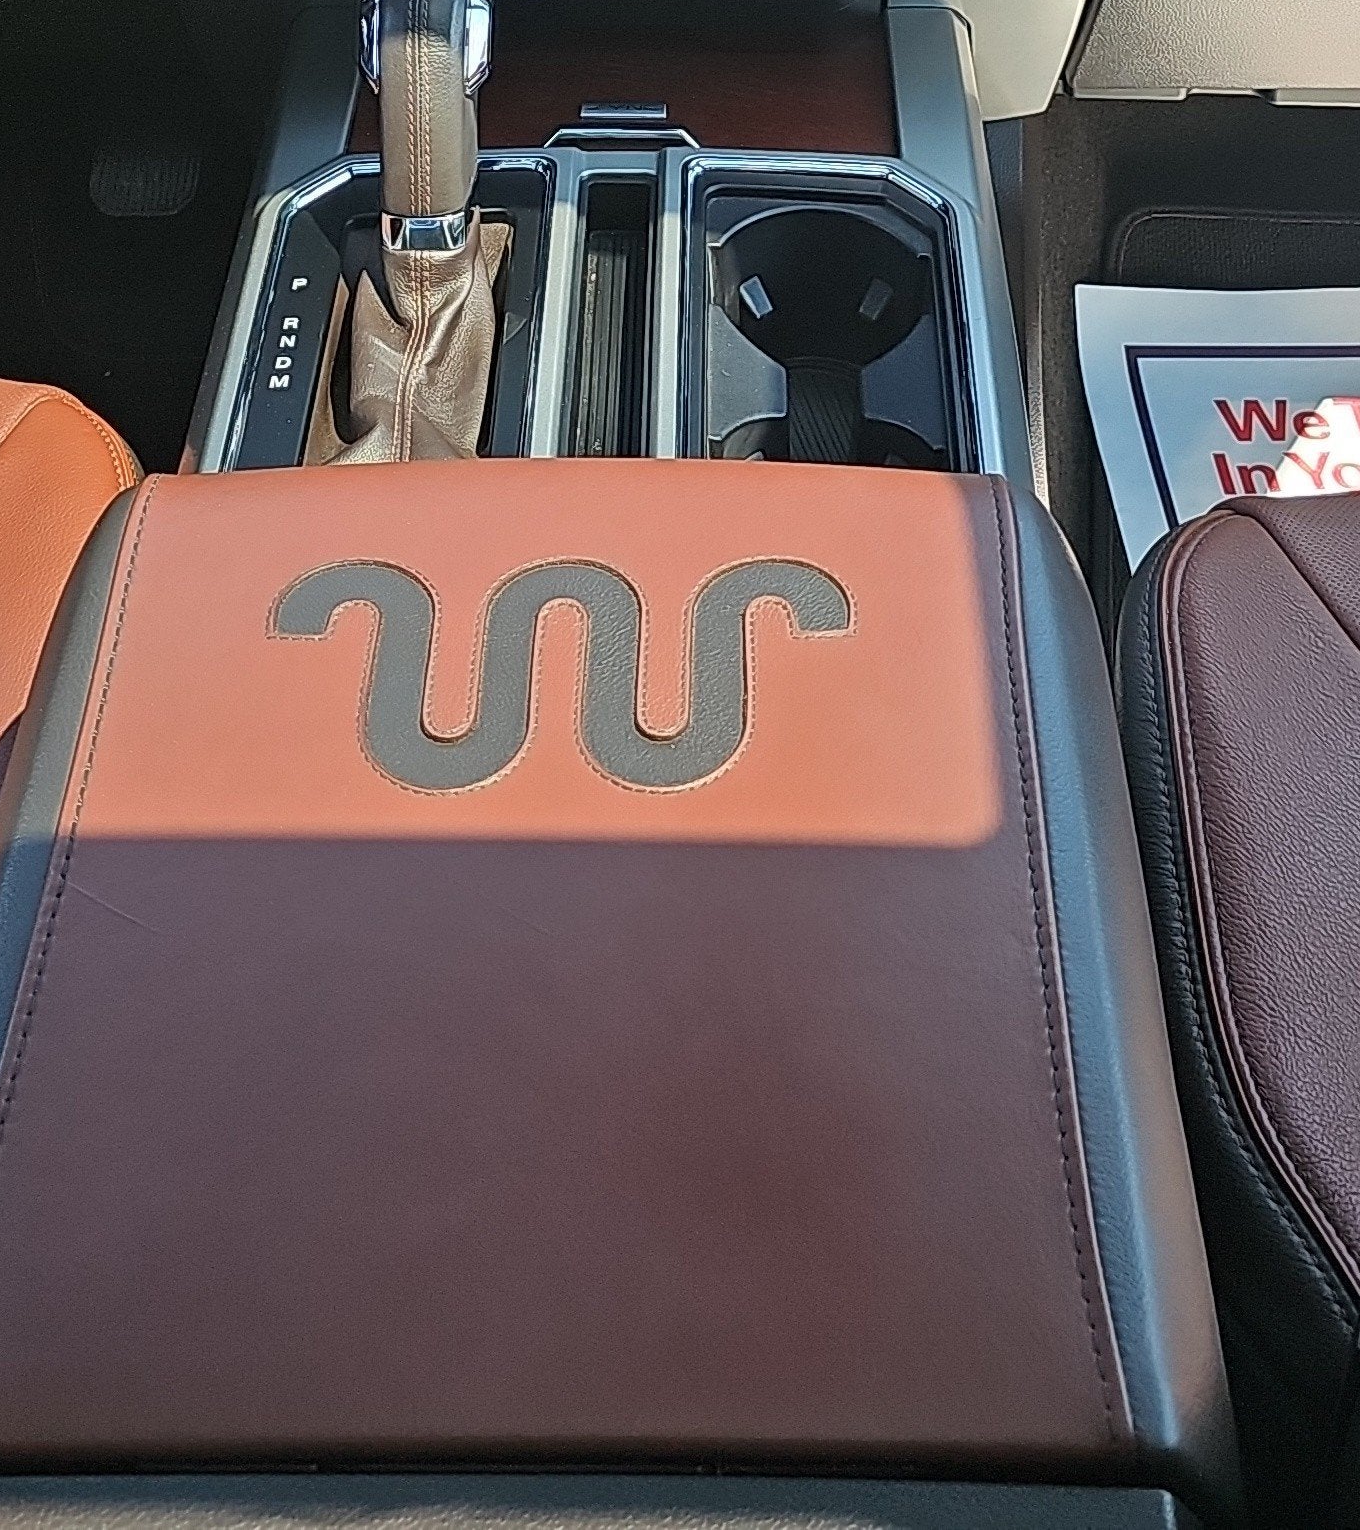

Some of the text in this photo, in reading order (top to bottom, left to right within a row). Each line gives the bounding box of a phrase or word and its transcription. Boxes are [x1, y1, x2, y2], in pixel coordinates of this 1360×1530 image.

[291, 278, 308, 291] P
[282, 317, 300, 330] R
[279, 335, 296, 348] N
[275, 357, 291, 369] D
[268, 375, 289, 388] M
[1212, 398, 1330, 442] We
[1212, 452, 1281, 495] In
